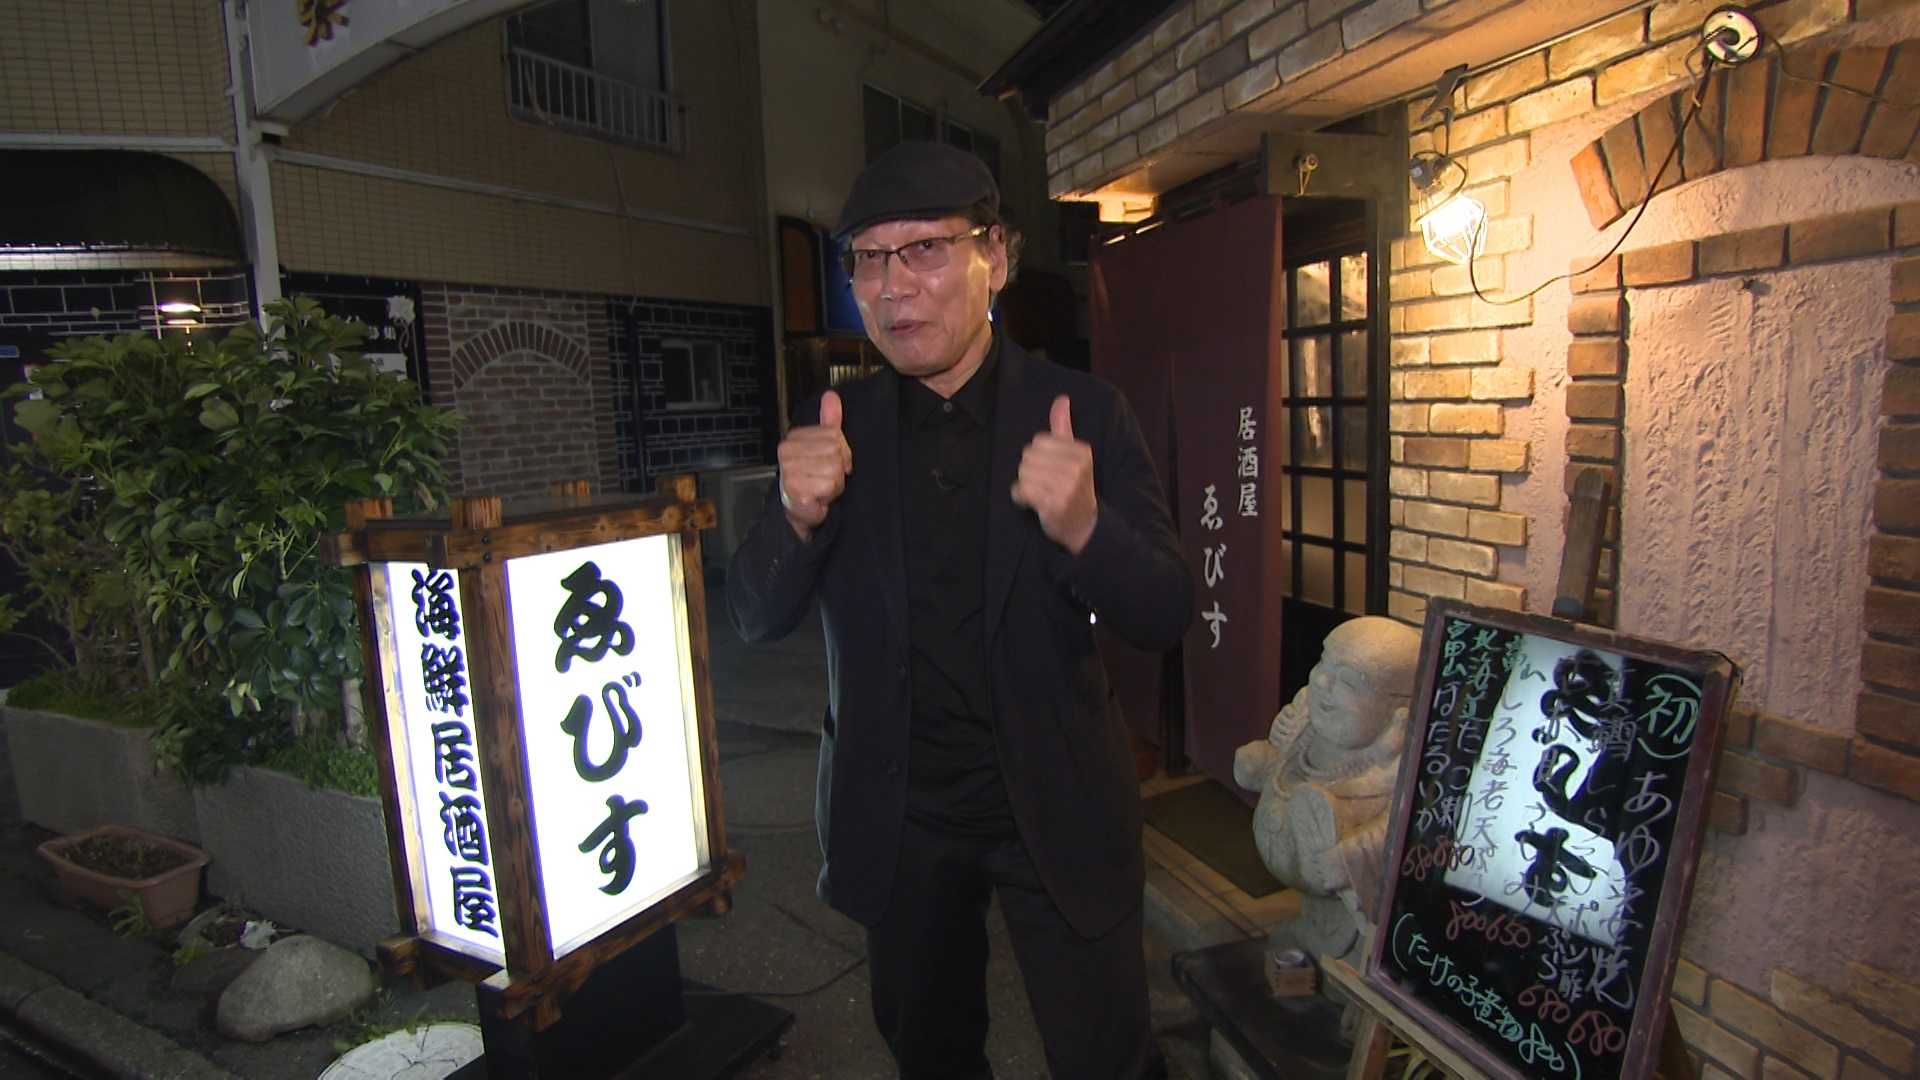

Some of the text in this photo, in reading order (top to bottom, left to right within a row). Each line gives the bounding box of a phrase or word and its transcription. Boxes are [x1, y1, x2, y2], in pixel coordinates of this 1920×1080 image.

[1238, 407, 1258, 517] 居酒屋
[1200, 484, 1227, 648] ゑびす
[412, 568, 499, 937] 海鮮居酒屋
[554, 561, 648, 895] ゑびす
[1486, 912, 1532, 949] 650
[1566, 1010, 1627, 1057] 680
